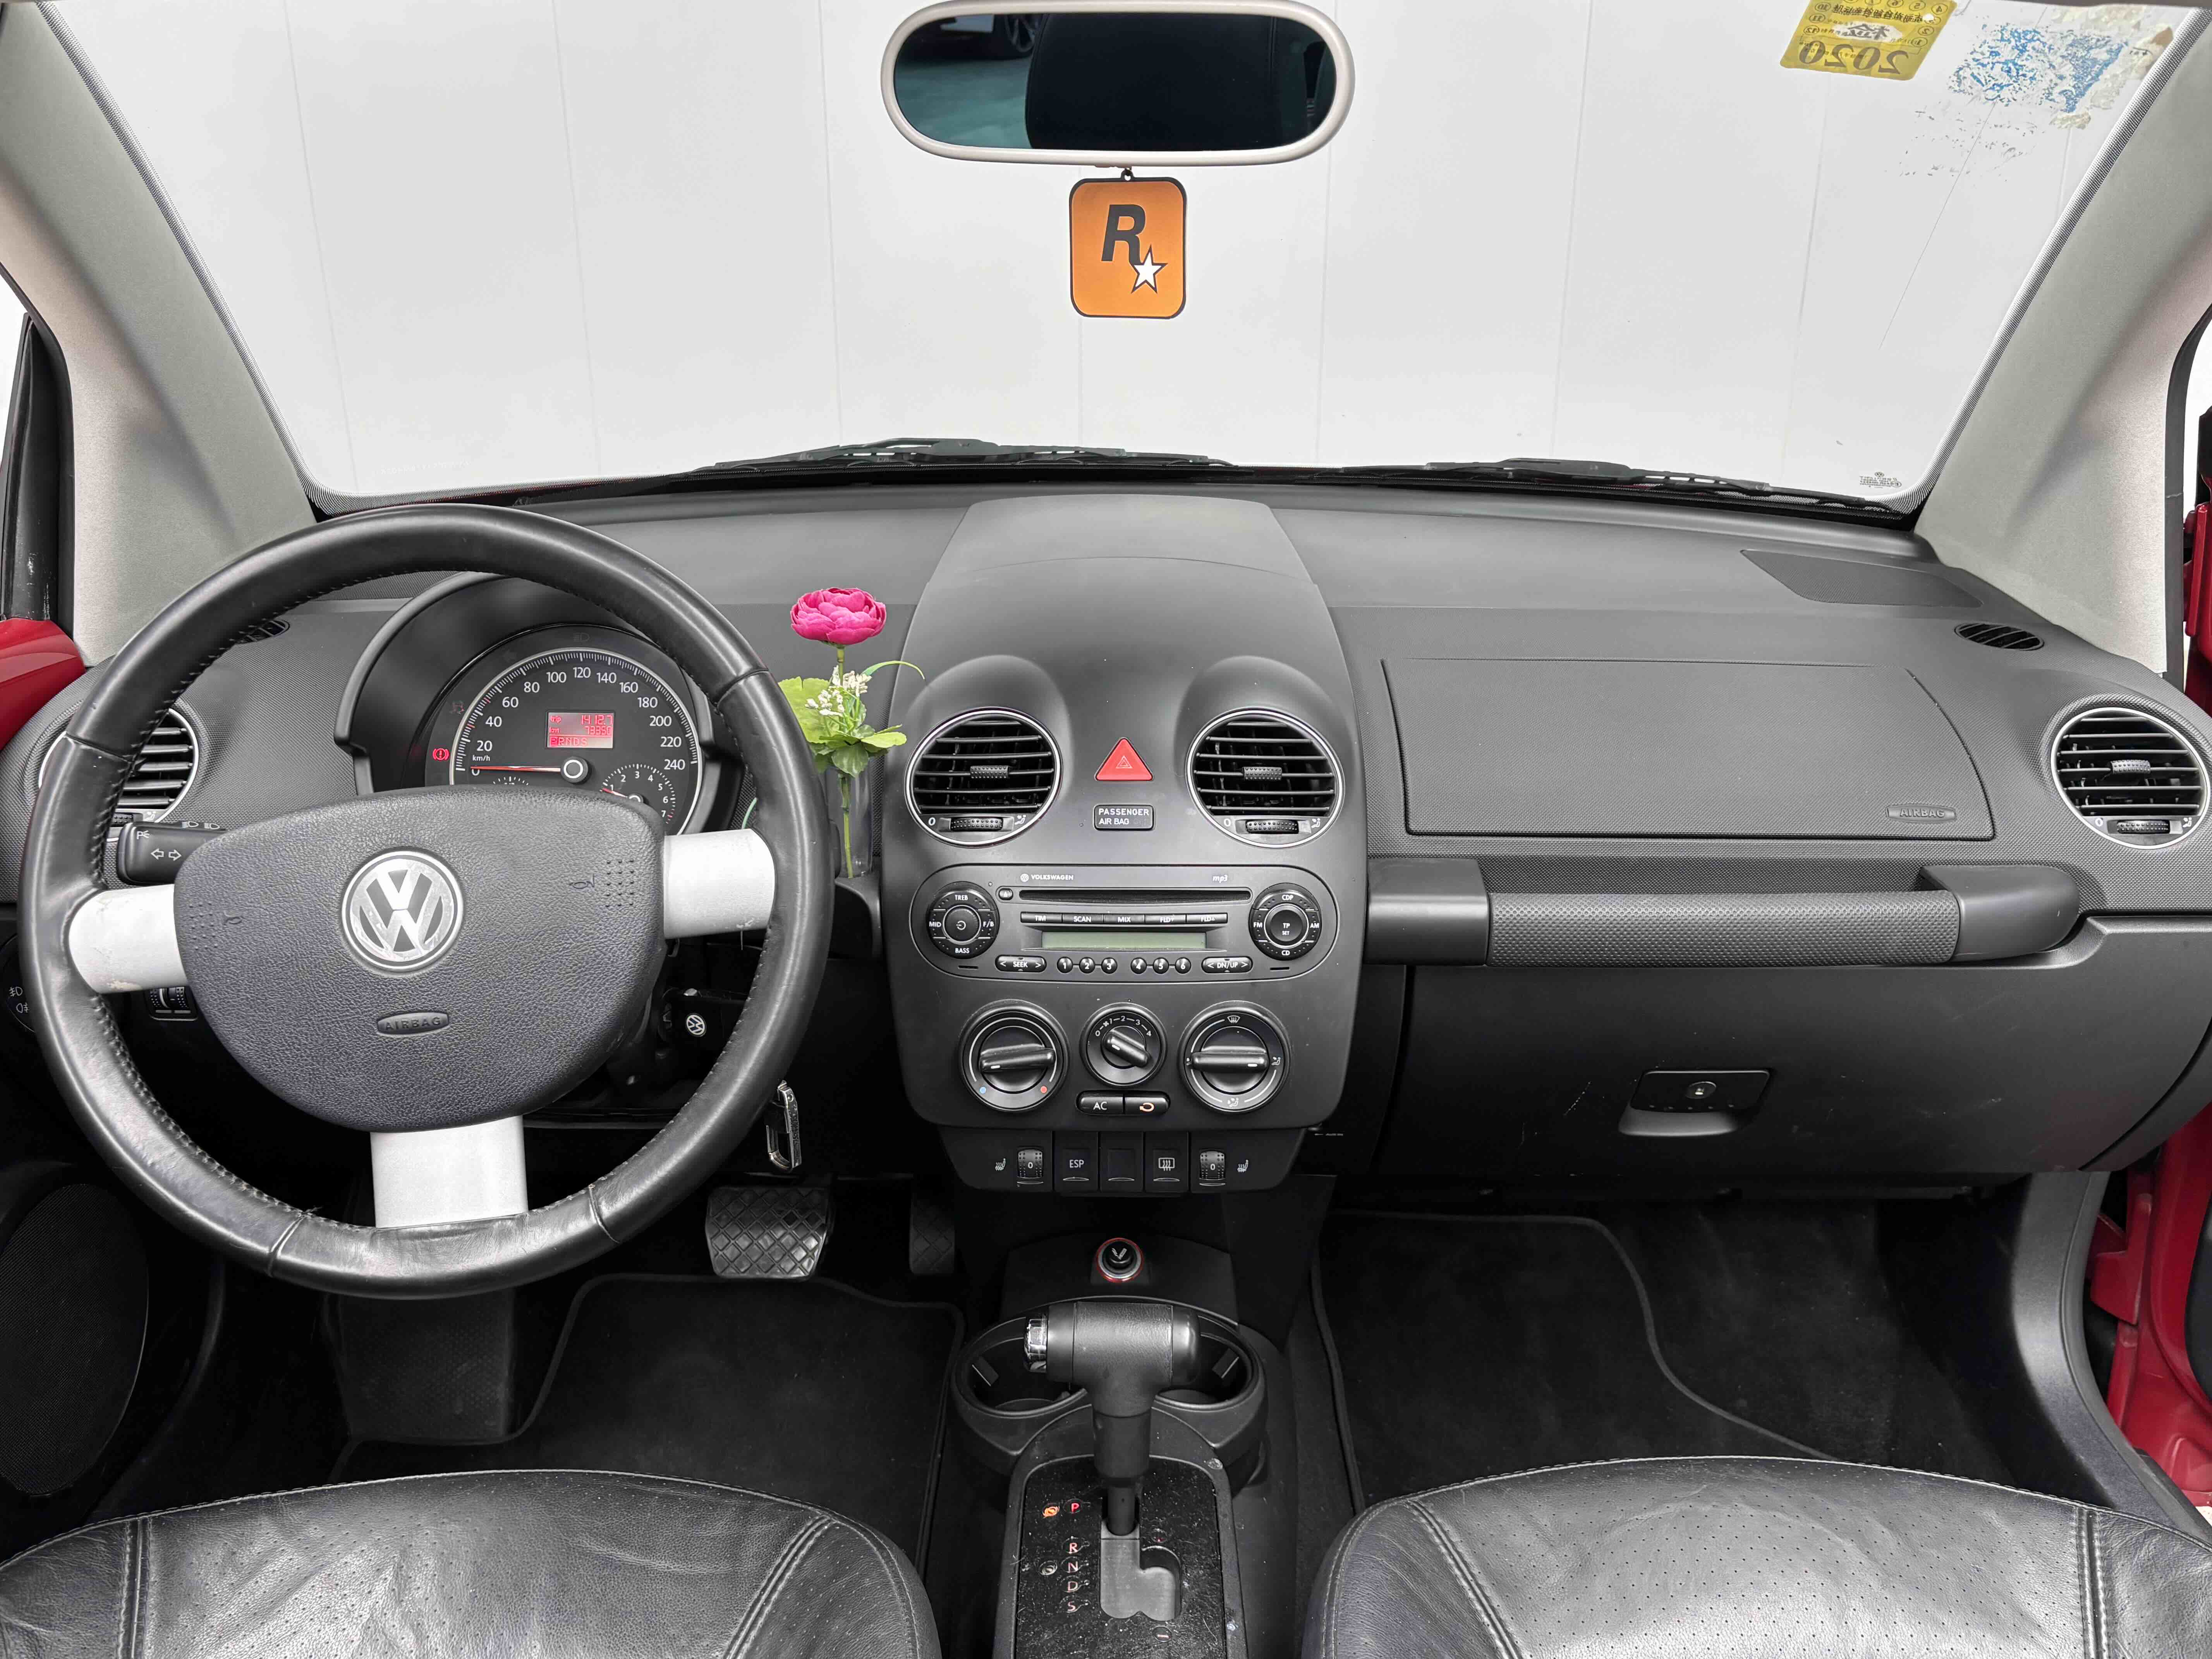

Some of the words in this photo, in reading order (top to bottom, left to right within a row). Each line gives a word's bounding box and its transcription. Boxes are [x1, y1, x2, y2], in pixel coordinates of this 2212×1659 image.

[1101, 204, 1146, 265] R
[546, 672, 567, 683] 100
[573, 667, 591, 678] 120
[596, 672, 617, 684] 140
[524, 682, 540, 693] 80
[620, 682, 638, 694] 160
[502, 697, 519, 708] 60
[638, 697, 658, 708] 180
[485, 716, 502, 728] 40
[649, 716, 672, 727] 200
[477, 740, 493, 751] 20
[660, 736, 681, 748] 220
[664, 759, 685, 771] 240
[1900, 808, 1945, 817] AIRBAG
[1212, 874, 1228, 883] mp3
[385, 1015, 441, 1031] AIRBAG
[1092, 1101, 1108, 1111] AC
[1069, 1159, 1084, 1168] ESP
[1071, 1503, 1079, 1512] P
[1069, 1543, 1078, 1553] R
[1068, 1562, 1079, 1571] N
[1068, 1582, 1079, 1591] D
[1068, 1602, 1076, 1611] S
